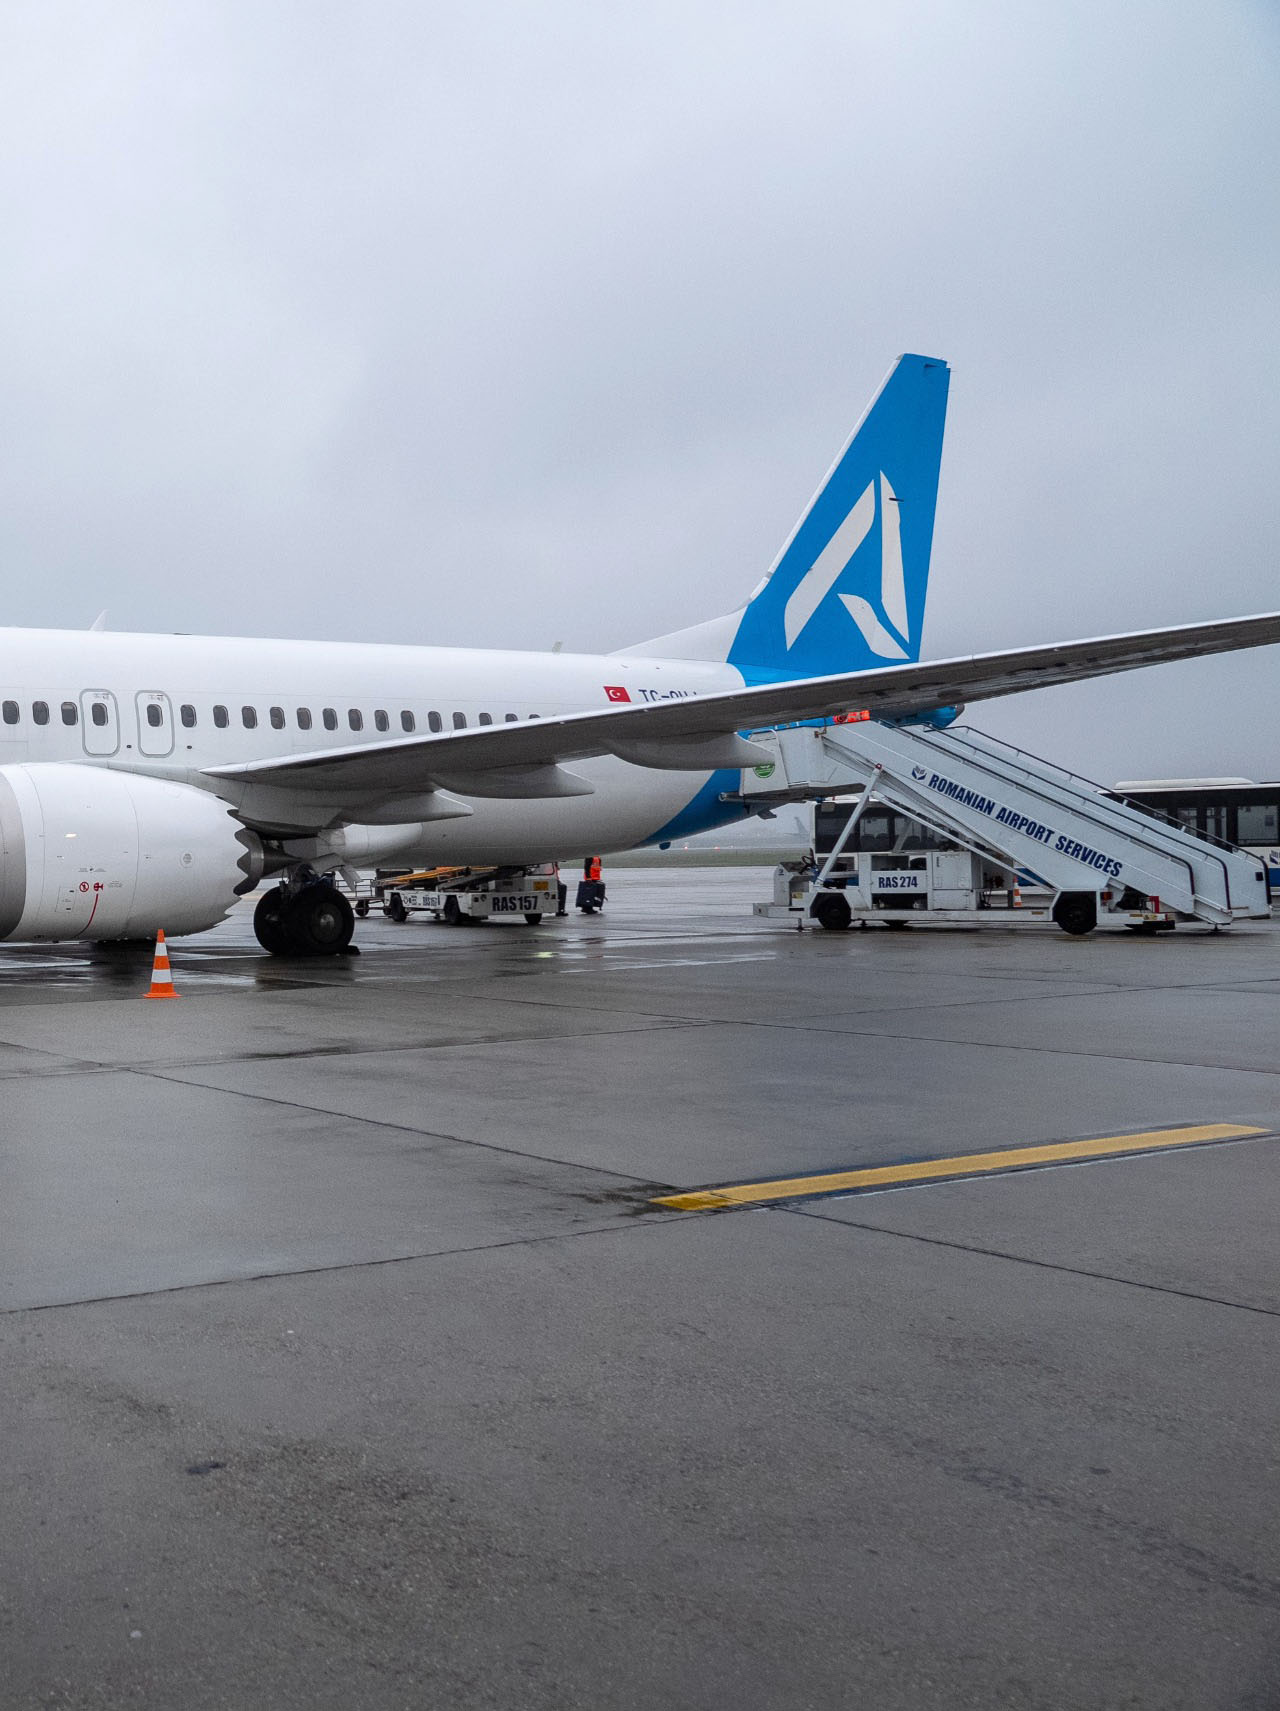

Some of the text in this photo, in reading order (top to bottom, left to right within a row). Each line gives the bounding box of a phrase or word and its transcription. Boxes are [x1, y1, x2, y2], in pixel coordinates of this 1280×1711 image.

[638, 689, 697, 702] TC-O
[928, 774, 1123, 877] ROMANIAN AIRPORT SERVICES
[878, 876, 918, 888] RAS 274
